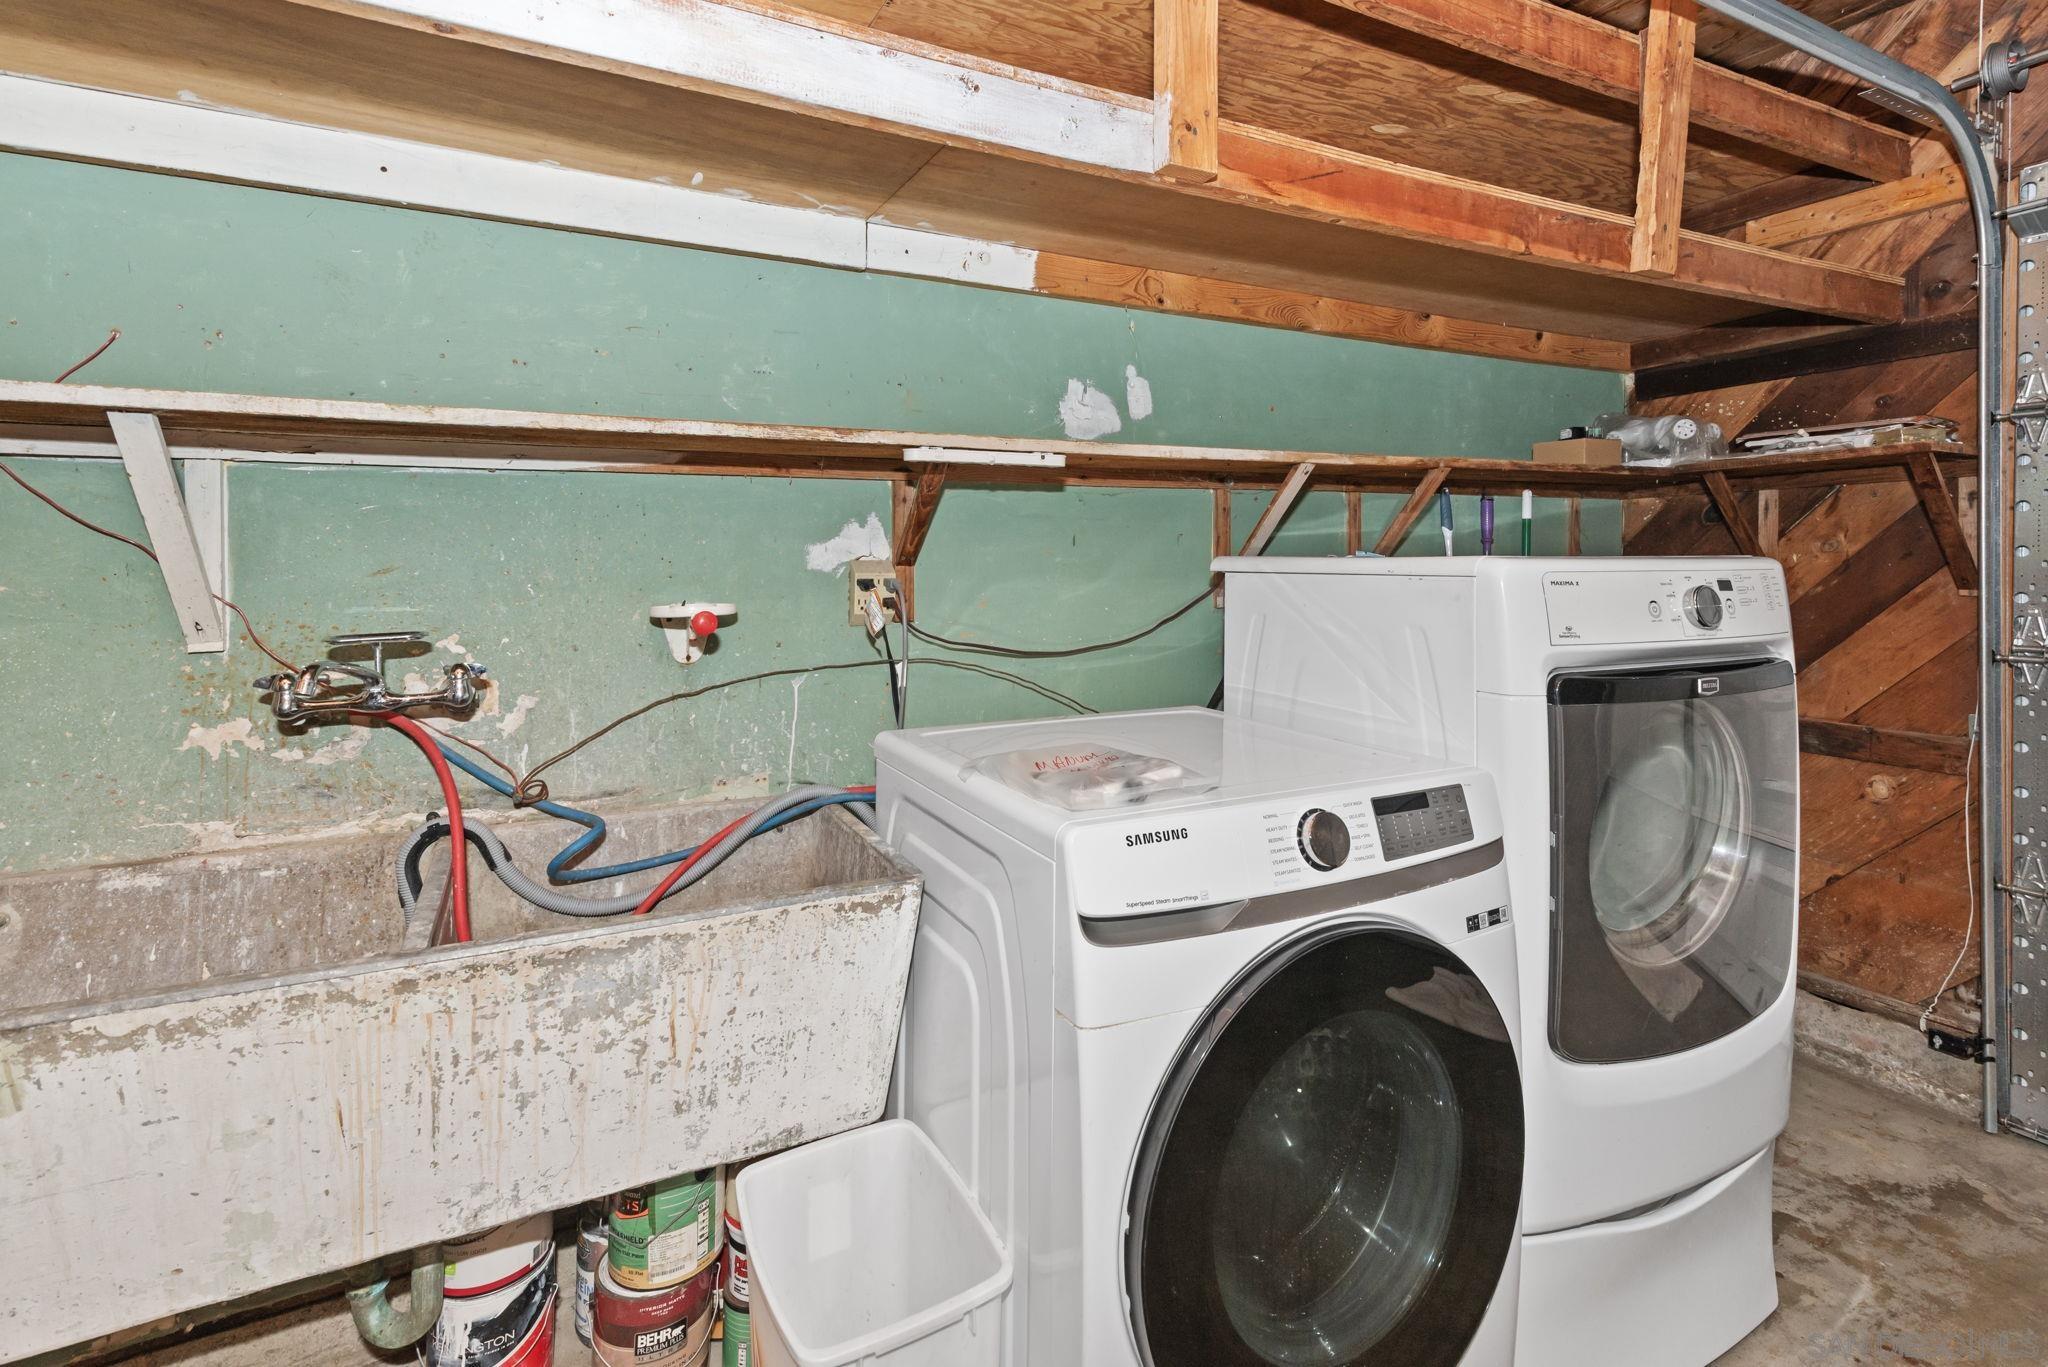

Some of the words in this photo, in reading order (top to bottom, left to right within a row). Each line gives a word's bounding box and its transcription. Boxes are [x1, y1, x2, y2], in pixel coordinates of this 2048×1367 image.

[1125, 827, 1189, 847] SAMSUNG
[1126, 899, 1154, 908] SuperSpeed
[1171, 895, 1199, 904] SmartThings
[636, 1341, 669, 1356] PREMIUM
[669, 1332, 685, 1346] PLUS
[637, 1328, 671, 1348] BEHR
